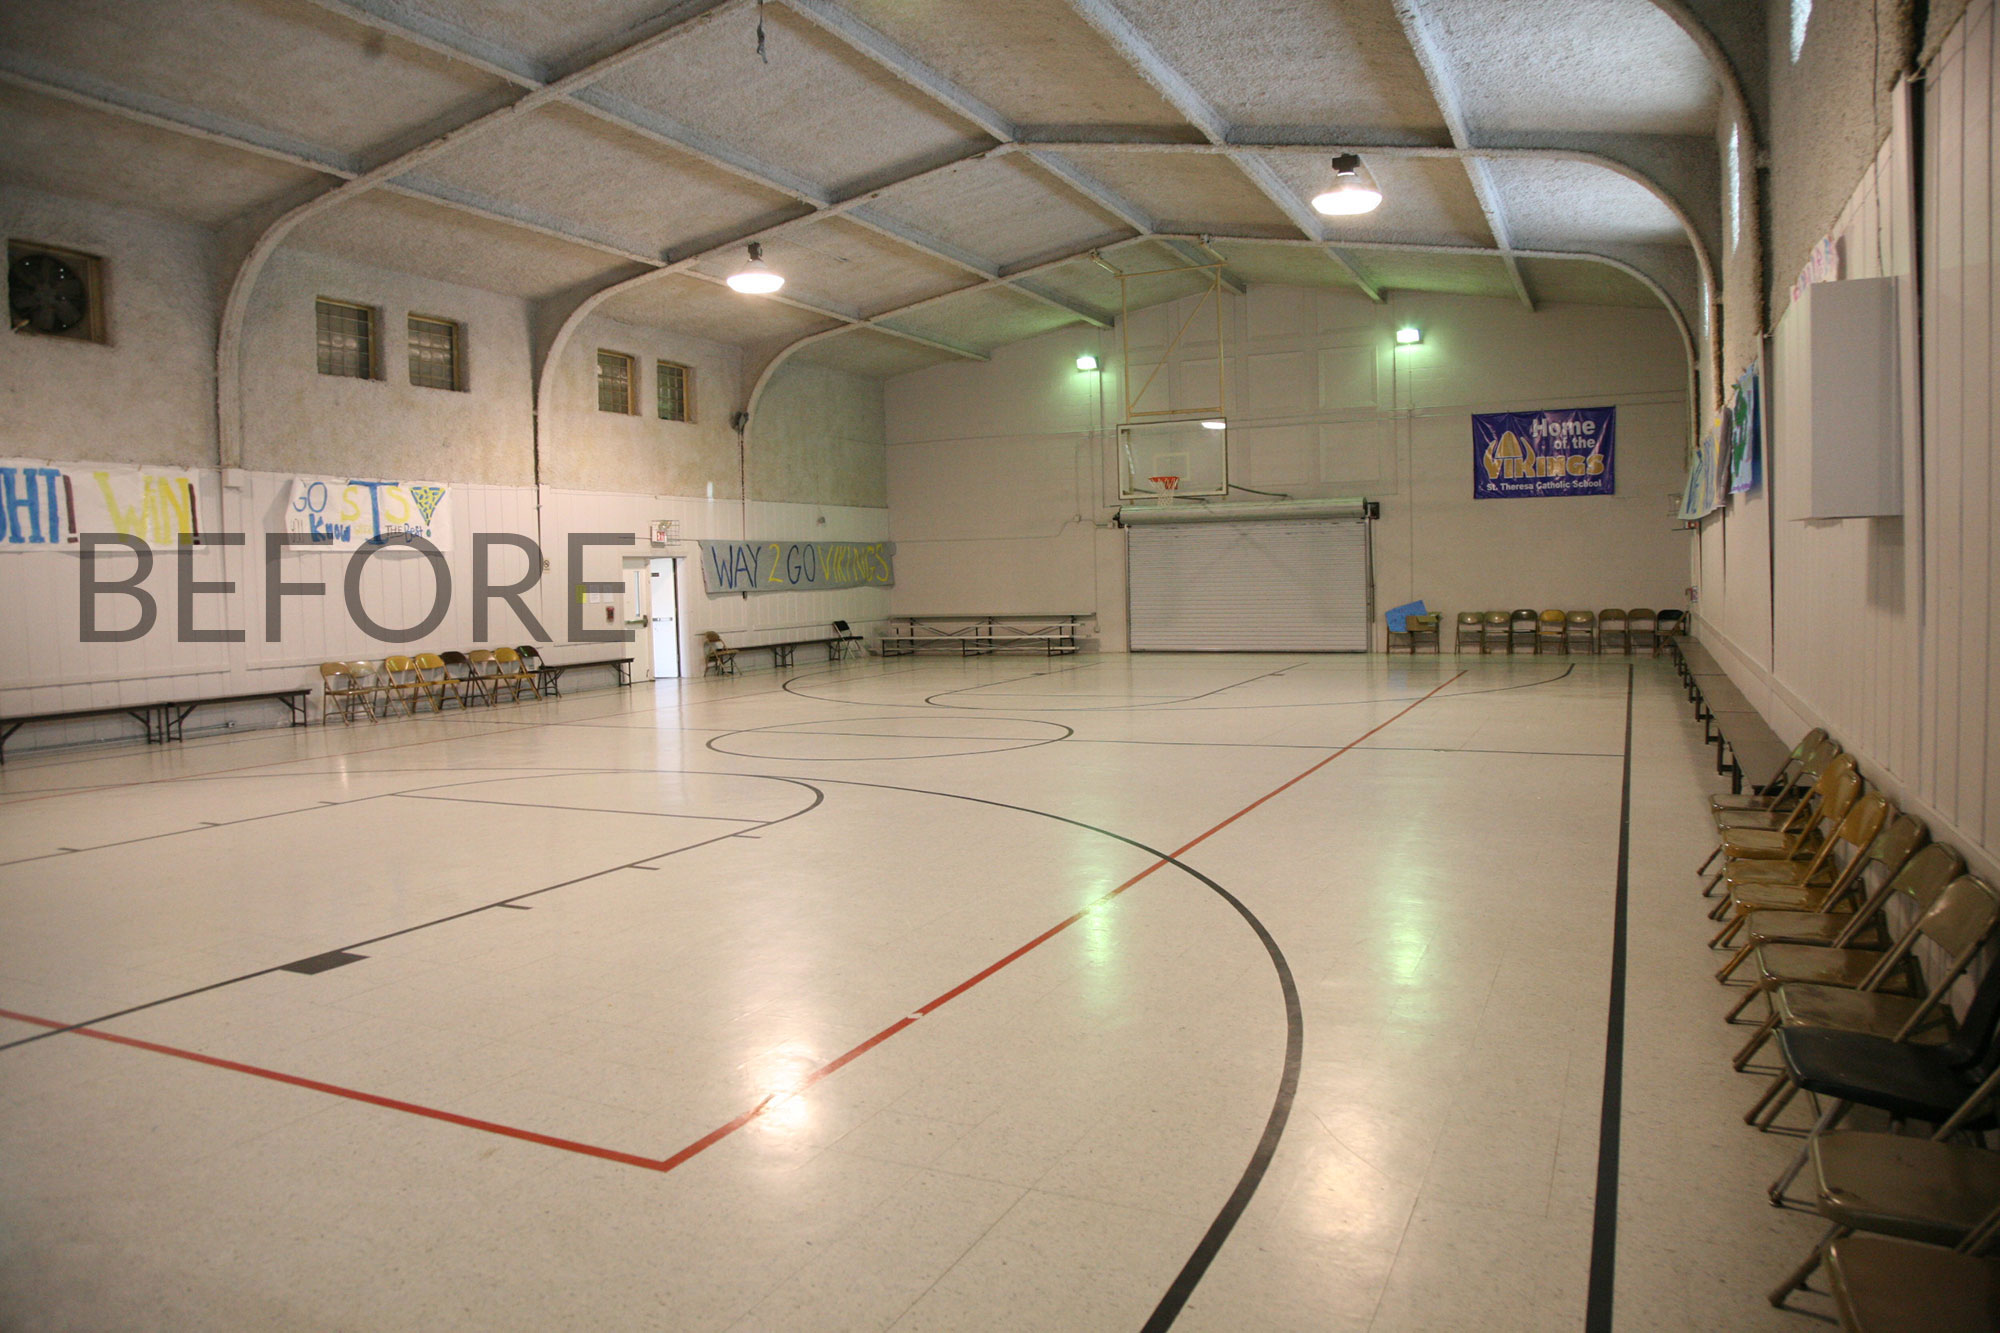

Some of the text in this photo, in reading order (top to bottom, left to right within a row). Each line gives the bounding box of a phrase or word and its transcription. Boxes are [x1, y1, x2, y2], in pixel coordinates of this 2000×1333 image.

[1532, 418, 1596, 438] Home
[1484, 439, 1605, 479] VIKINGS
[1554, 438, 1596, 450] of the
[1486, 479, 1602, 491] St. Theresa Catholic School
[0, 467, 78, 544] HT!
[711, 543, 889, 589] WAY 2 GO VIKINGS
